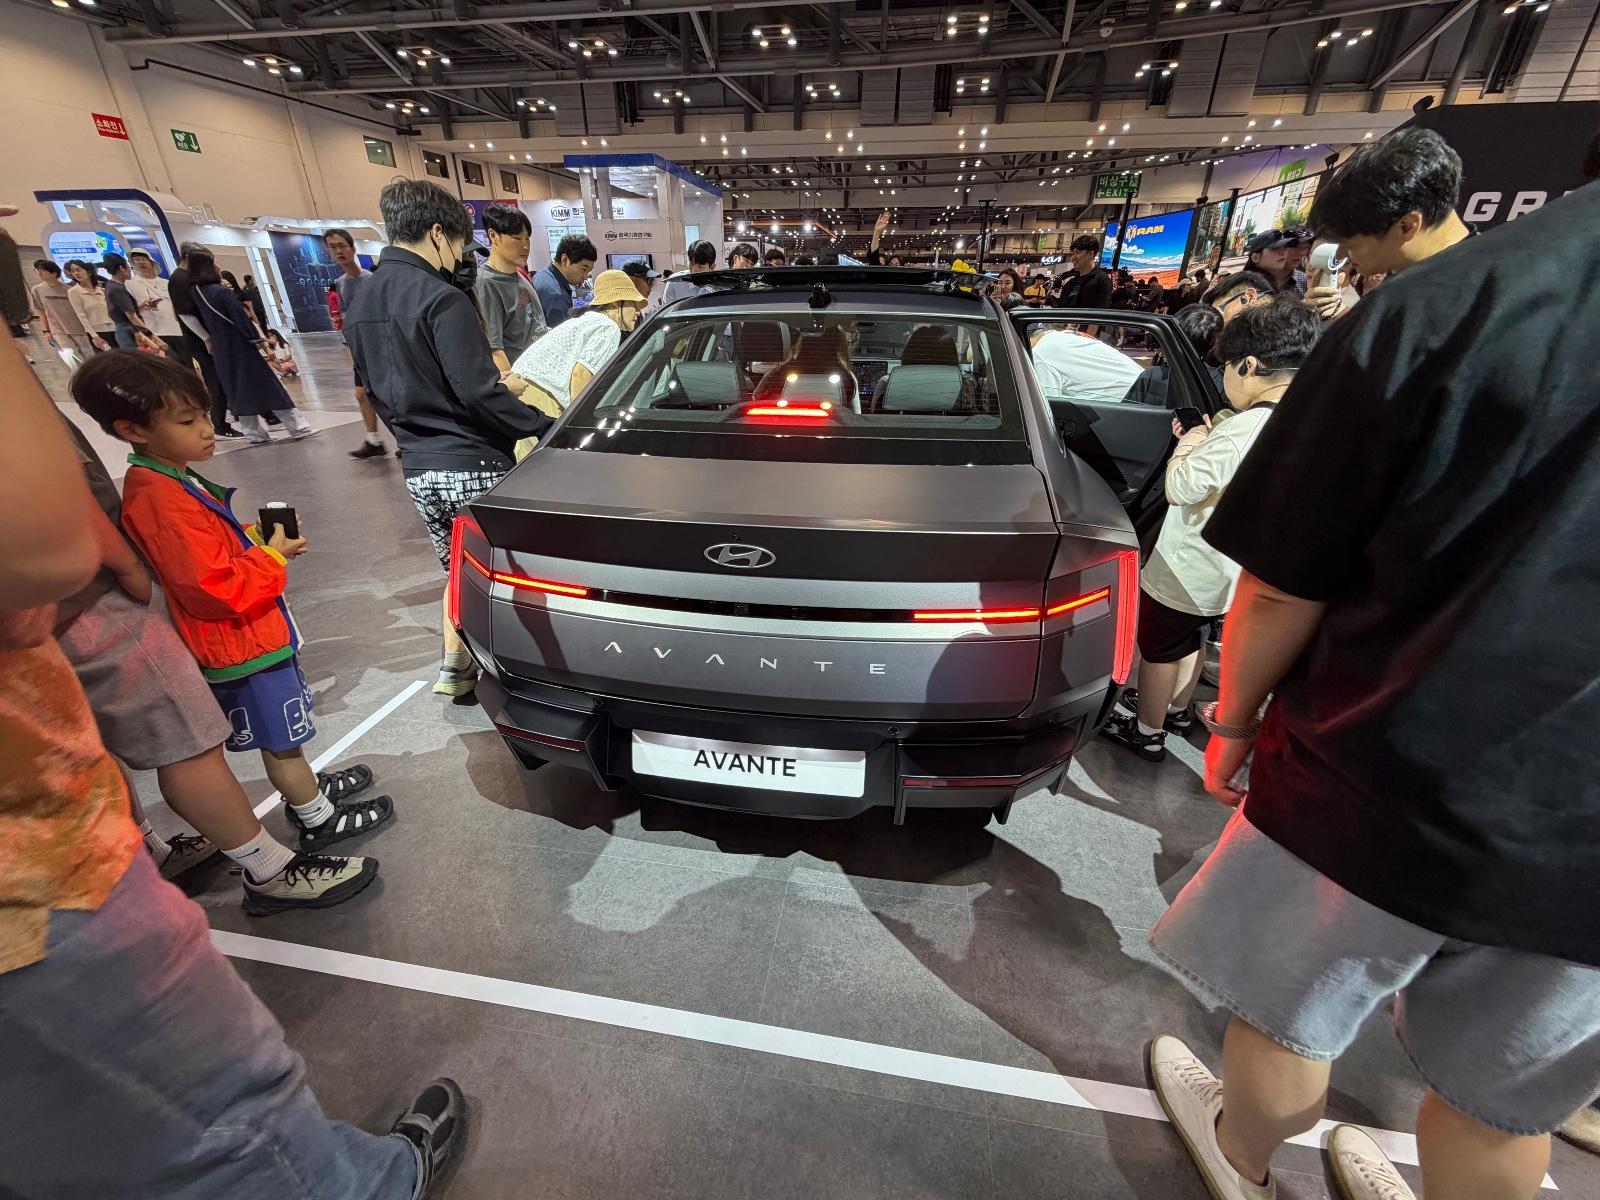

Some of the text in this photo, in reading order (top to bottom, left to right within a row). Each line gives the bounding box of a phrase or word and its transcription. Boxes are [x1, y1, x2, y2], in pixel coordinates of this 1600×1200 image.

[1100, 175, 1128, 187] 비상구
[1106, 188, 1128, 197] EXIT
[1462, 190, 1575, 222] GR
[550, 208, 571, 218] KIMM
[1136, 224, 1165, 235] RAM
[604, 641, 887, 675] AVANTE
[693, 749, 797, 778] AVANTE
